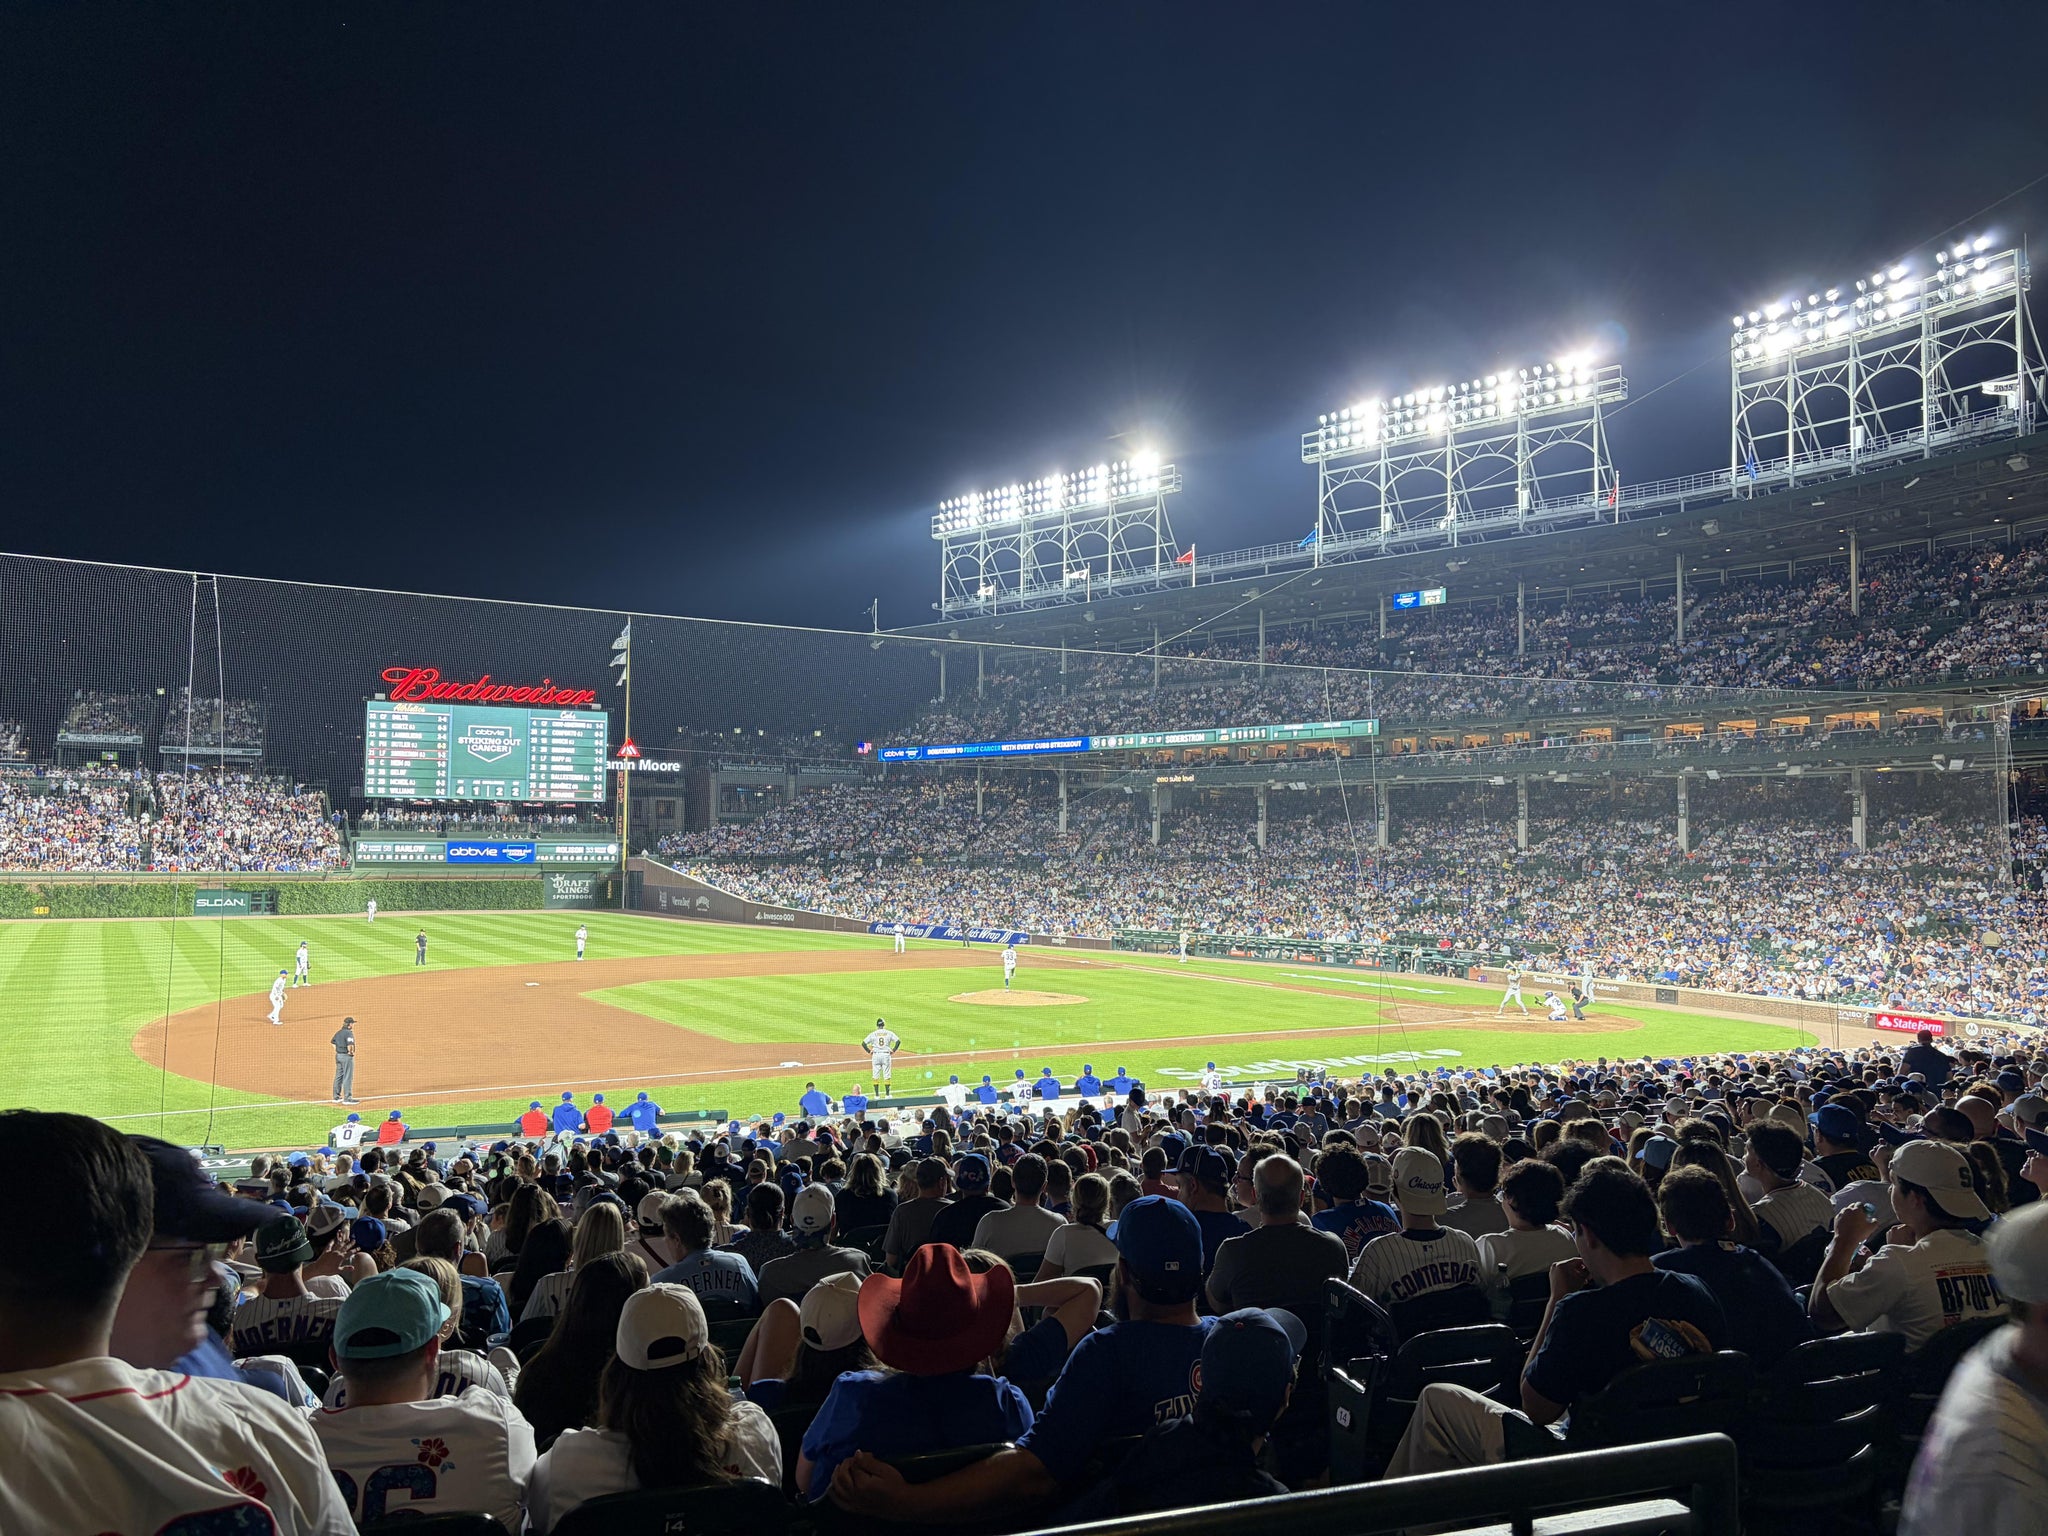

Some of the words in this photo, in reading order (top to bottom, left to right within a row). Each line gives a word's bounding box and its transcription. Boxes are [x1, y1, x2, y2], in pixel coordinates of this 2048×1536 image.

[381, 667, 596, 705] Budweiser
[458, 737, 502, 745] STRIKING
[503, 738, 521, 746] OUT
[1050, 740, 1082, 748] STRIKEOUT
[1165, 733, 1205, 744] SODERSTROM
[471, 744, 508, 752] CANCER
[606, 759, 636, 770] amin
[639, 759, 681, 771] Moore
[1182, 774, 1195, 782] level
[449, 847, 498, 856] abbvie
[553, 880, 591, 888] DRAFT
[763, 912, 783, 922] Invesco
[904, 927, 925, 939] Wrap
[978, 931, 1000, 943] Wrap
[1597, 984, 1619, 992] Advocate
[1893, 1018, 1917, 1030] State
[1917, 1020, 1942, 1033] Farm
[878, 1037, 885, 1046] 8
[1018, 1089, 1032, 1100] 49
[343, 1129, 352, 1141] 0
[1408, 1176, 1442, 1193] Chicago
[679, 1270, 743, 1294] OERNER
[1391, 1261, 1479, 1299] CONTRERAS
[1339, 1411, 1347, 1421] 14
[665, 1519, 686, 1533] 14
